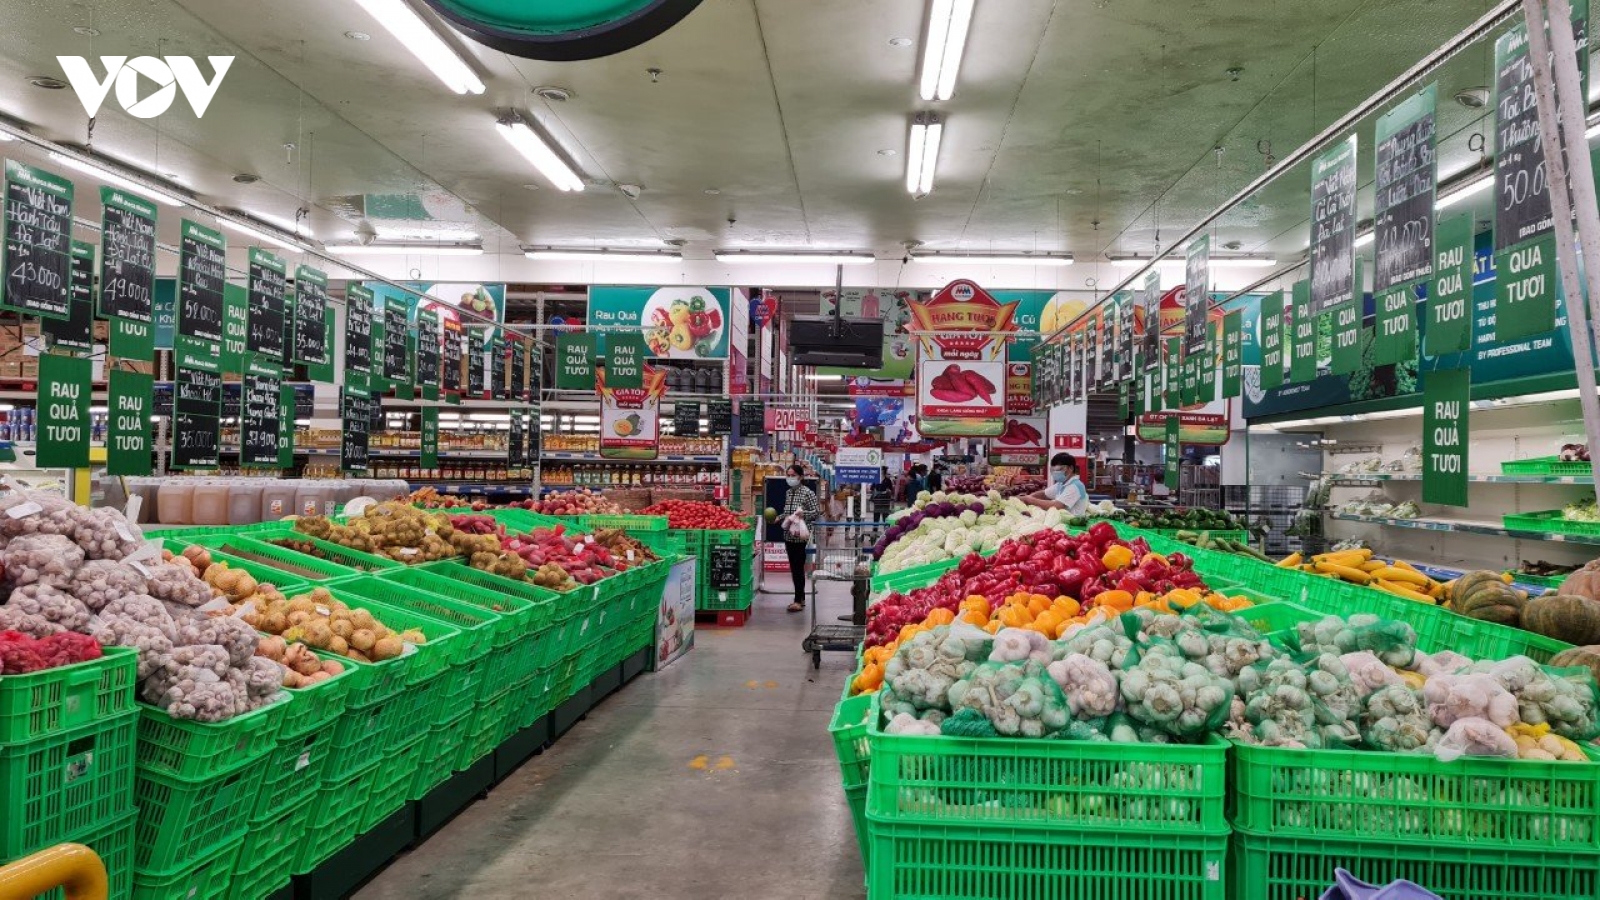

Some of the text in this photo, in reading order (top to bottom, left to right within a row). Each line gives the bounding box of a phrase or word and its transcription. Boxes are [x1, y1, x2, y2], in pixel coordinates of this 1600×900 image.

[1439, 245, 1464, 271] RAU
[1437, 268, 1463, 297] QUẢ
[1506, 274, 1545, 304] TƯƠI
[595, 310, 615, 320] Rau
[1298, 303, 1309, 319] RA
[1434, 298, 1465, 323] TƯƠI
[1265, 313, 1280, 331] RAU
[1382, 313, 1410, 336] TƯƠI
[1265, 327, 1280, 349] QUẢ
[1337, 328, 1357, 348] TƯƠI
[567, 345, 588, 354] RAU
[614, 345, 635, 354] RAU
[1264, 349, 1281, 367] TƯƠI
[1295, 340, 1314, 359] TƯƠI
[1478, 337, 1553, 360] BY PROFESSIONAL TEAM
[566, 354, 588, 365] QUẢ
[613, 354, 635, 365] QUẢ
[564, 366, 590, 375] TƯƠI
[612, 367, 637, 376] TƯƠI
[51, 381, 79, 399] RAU
[50, 399, 79, 421] QUẢ
[119, 395, 142, 411] RAU
[1435, 401, 1460, 420] RAU
[117, 411, 143, 431] QUẢ
[775, 410, 796, 429] 204
[46, 425, 81, 442] TƯƠI
[1434, 419, 1460, 446] QUẢ
[115, 436, 144, 451] TƯƠI
[1431, 453, 1461, 473] TƯƠI
